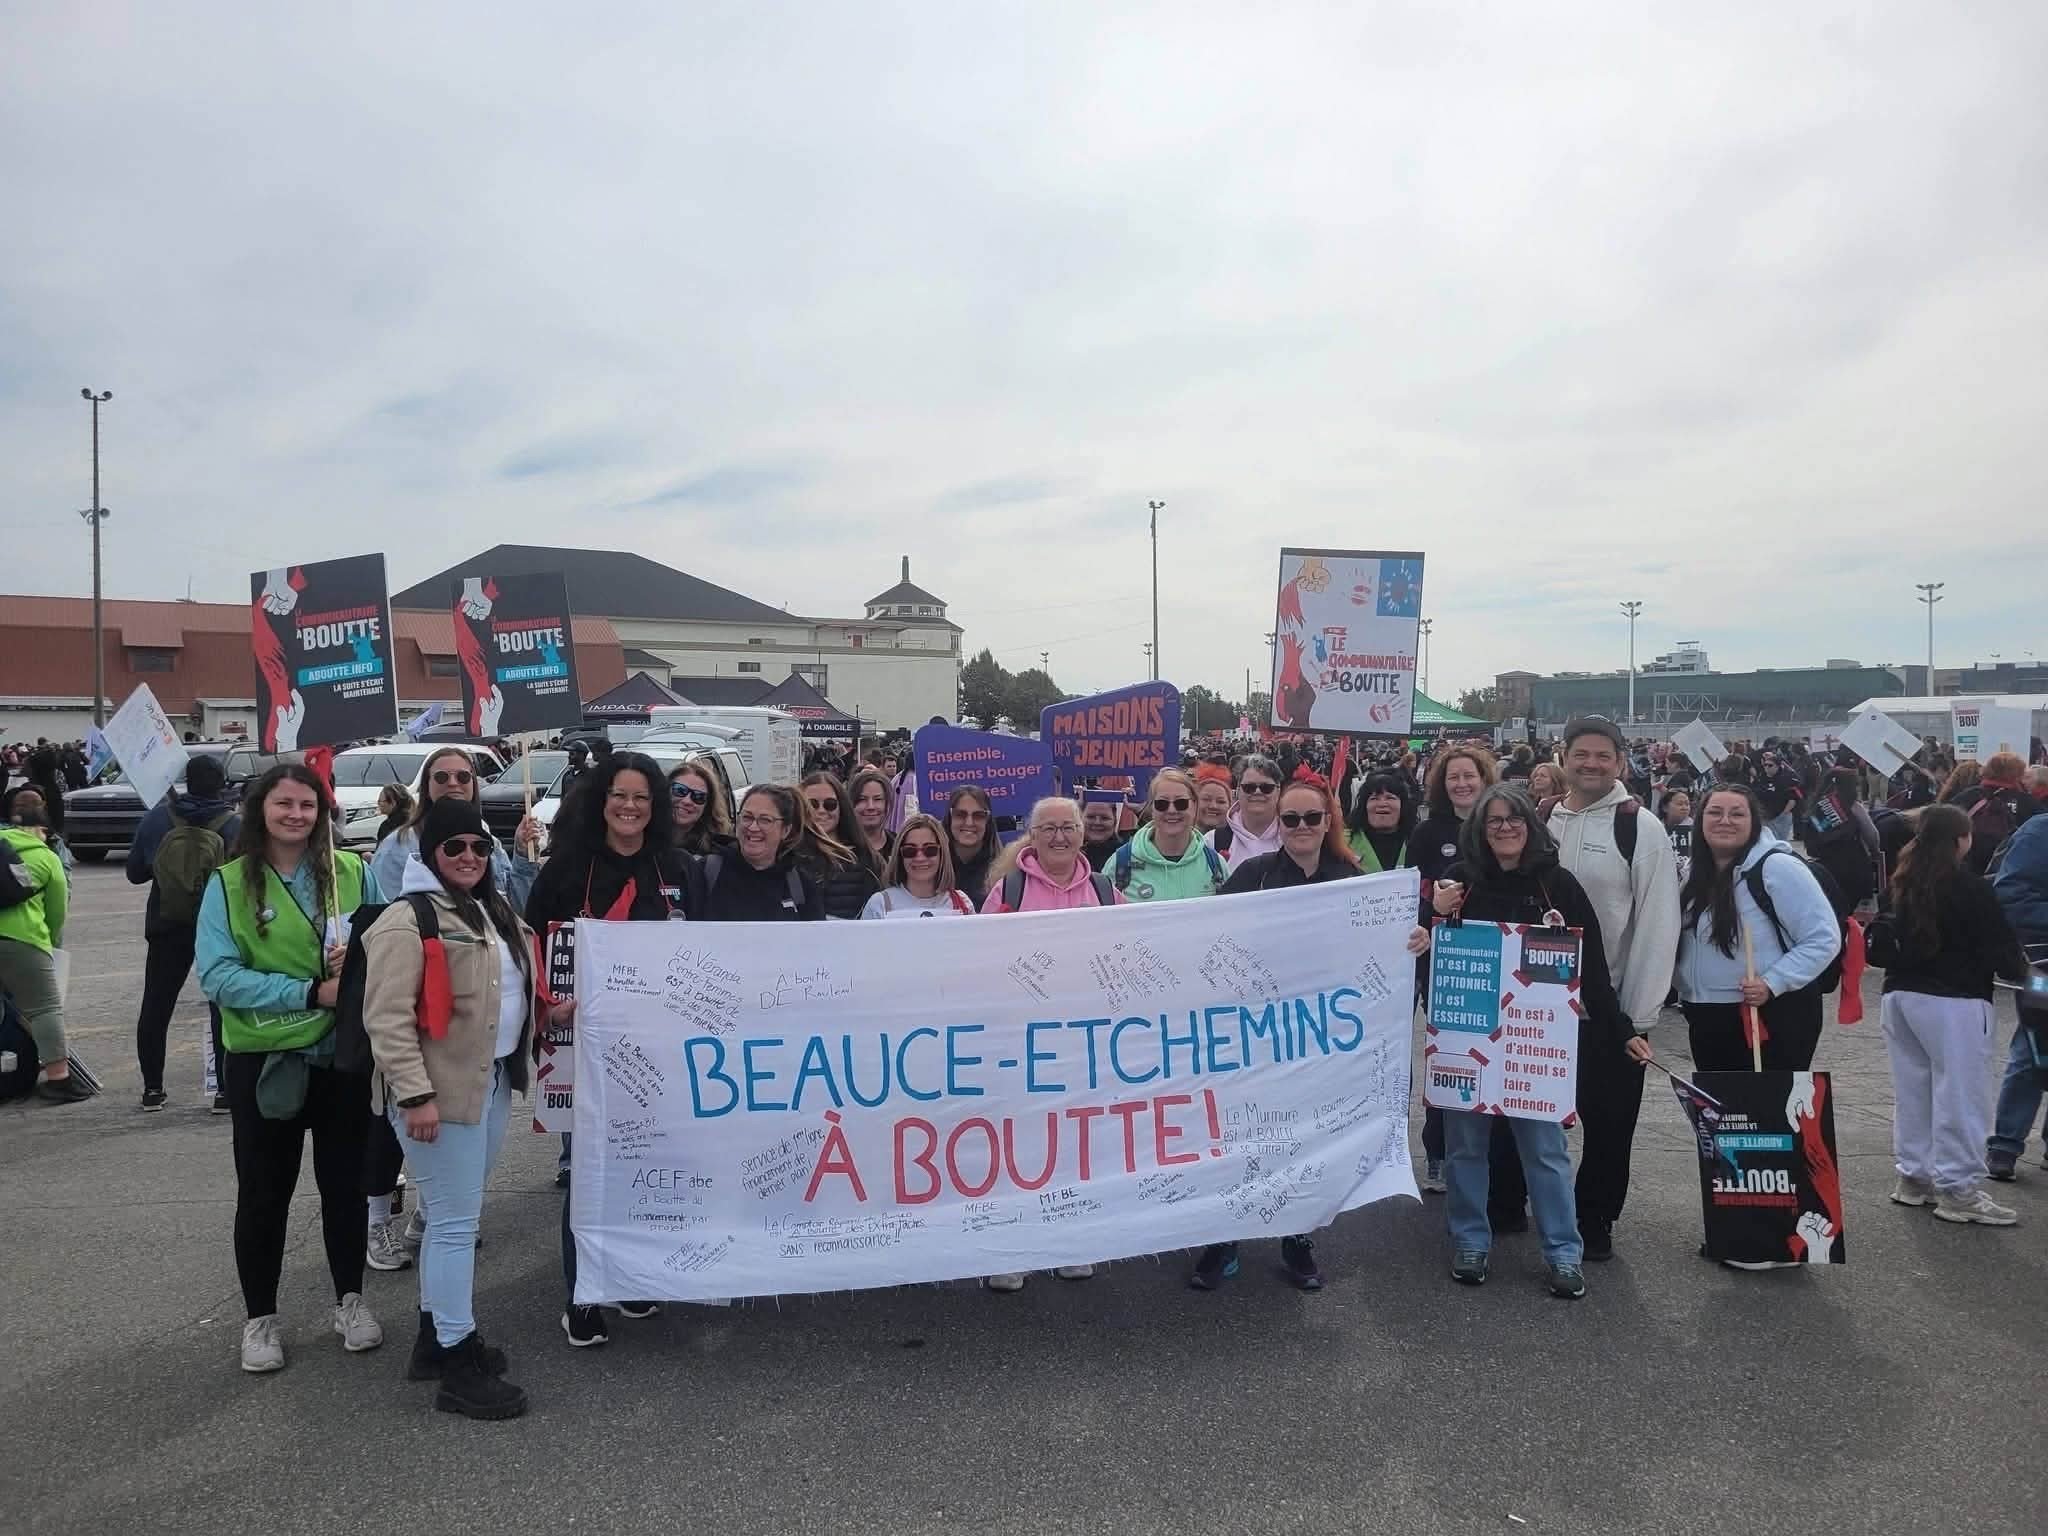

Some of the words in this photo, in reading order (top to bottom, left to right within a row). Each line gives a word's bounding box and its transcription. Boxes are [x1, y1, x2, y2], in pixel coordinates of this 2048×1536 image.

[303, 617, 381, 651] BOUTTE
[499, 627, 565, 653] BOUTTE
[1331, 636, 1347, 651] LE
[308, 662, 374, 682] ABOUTTE.INFO
[505, 665, 560, 679] ABOUTTE.INFO
[333, 685, 343, 693] LA
[342, 682, 361, 691] SUITE
[1340, 671, 1401, 694] BOUTTE
[343, 687, 385, 699] MAINTENANT.
[588, 704, 645, 712] IMPACT
[1054, 697, 1165, 737] MAISONS
[813, 722, 853, 732] DOMICILE
[927, 747, 1006, 763] Ensemble,
[1054, 739, 1071, 757] DES
[1074, 740, 1166, 769] JEUNES
[928, 768, 983, 783] faisons
[987, 763, 1042, 779] bouger
[930, 787, 951, 801] les
[554, 931, 563, 946] À
[567, 933, 575, 946] b
[1438, 929, 1452, 941] Le
[554, 952, 569, 966] de
[1437, 945, 1499, 958] communautaire
[1528, 949, 1576, 968] BOUTTE
[1437, 958, 1466, 972] n'est
[1470, 961, 1492, 974] pas
[552, 972, 575, 985] tair
[1436, 975, 1497, 993] OPTIONNEL.
[1446, 994, 1465, 1006] est
[1434, 1010, 1489, 1027] ESSENTIEL
[1507, 1006, 1521, 1019] On
[1525, 1009, 1544, 1021] est
[1547, 1009, 1554, 1022] à
[1506, 1023, 1545, 1039] boutte
[619, 1034, 631, 1049] Le
[631, 1046, 665, 1082] Berceau
[684, 988, 1364, 1119] BEAUCE-ETCHEMINS
[1505, 1060, 1519, 1073] On
[1523, 1063, 1548, 1076] veut
[1552, 1066, 1567, 1078] se
[544, 1083, 573, 1093] COMMUN
[1433, 1072, 1477, 1091] BOUTTE
[547, 1093, 573, 1109] BOU
[1503, 1096, 1556, 1113] entendre
[1223, 1106, 1240, 1126] Le
[1244, 1102, 1300, 1125] Murmure
[804, 1110, 868, 1202] À
[893, 1089, 1223, 1204] BOUTTE!
[1719, 1136, 1784, 1148] ABOUTTE.INFO
[631, 1167, 689, 1190] ACEF
[1713, 1169, 1789, 1193] BOUTTE
[1040, 1187, 1079, 1206] MFBE
[778, 1243, 805, 1258] SANS
